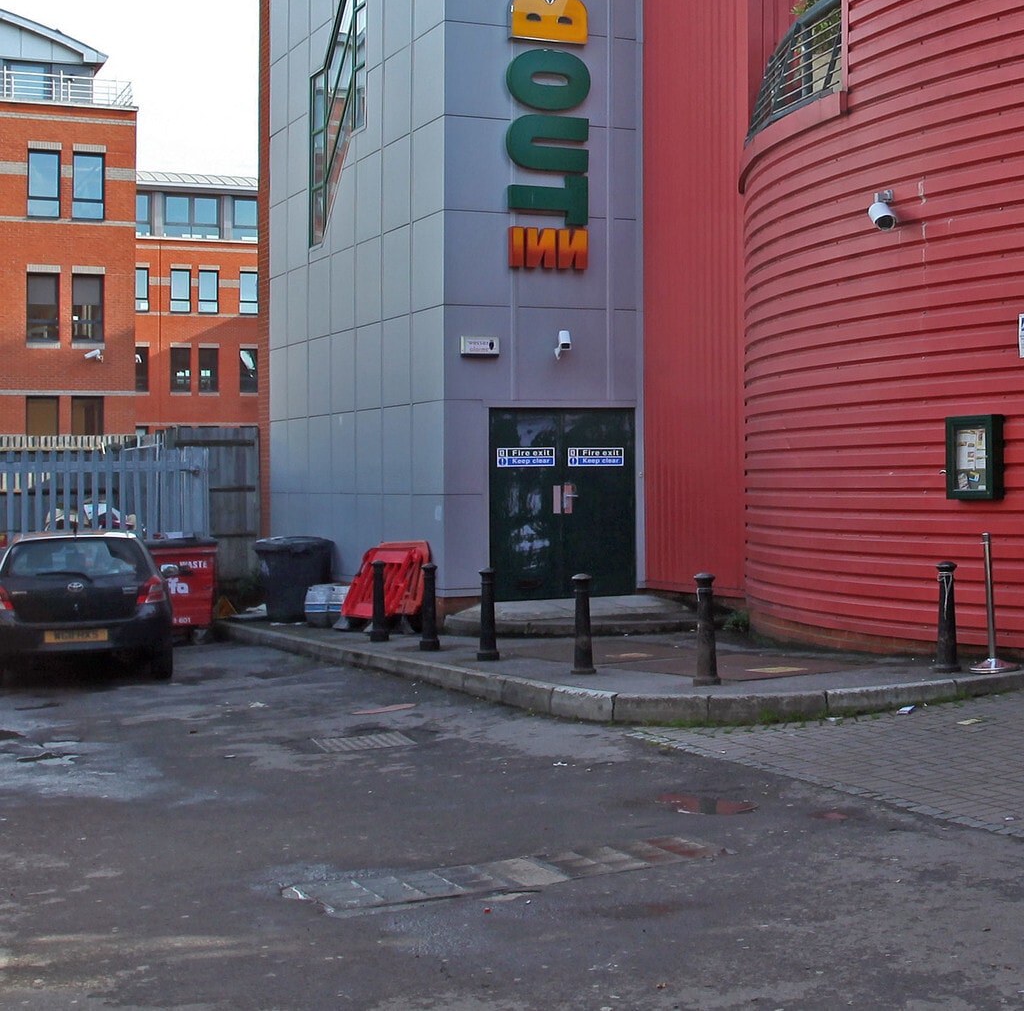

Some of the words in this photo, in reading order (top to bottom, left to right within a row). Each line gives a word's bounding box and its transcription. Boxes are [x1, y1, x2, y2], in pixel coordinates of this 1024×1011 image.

[508, 226, 588, 268] INN
[582, 457, 601, 465] Keep
[179, 560, 208, 569] WASTE
